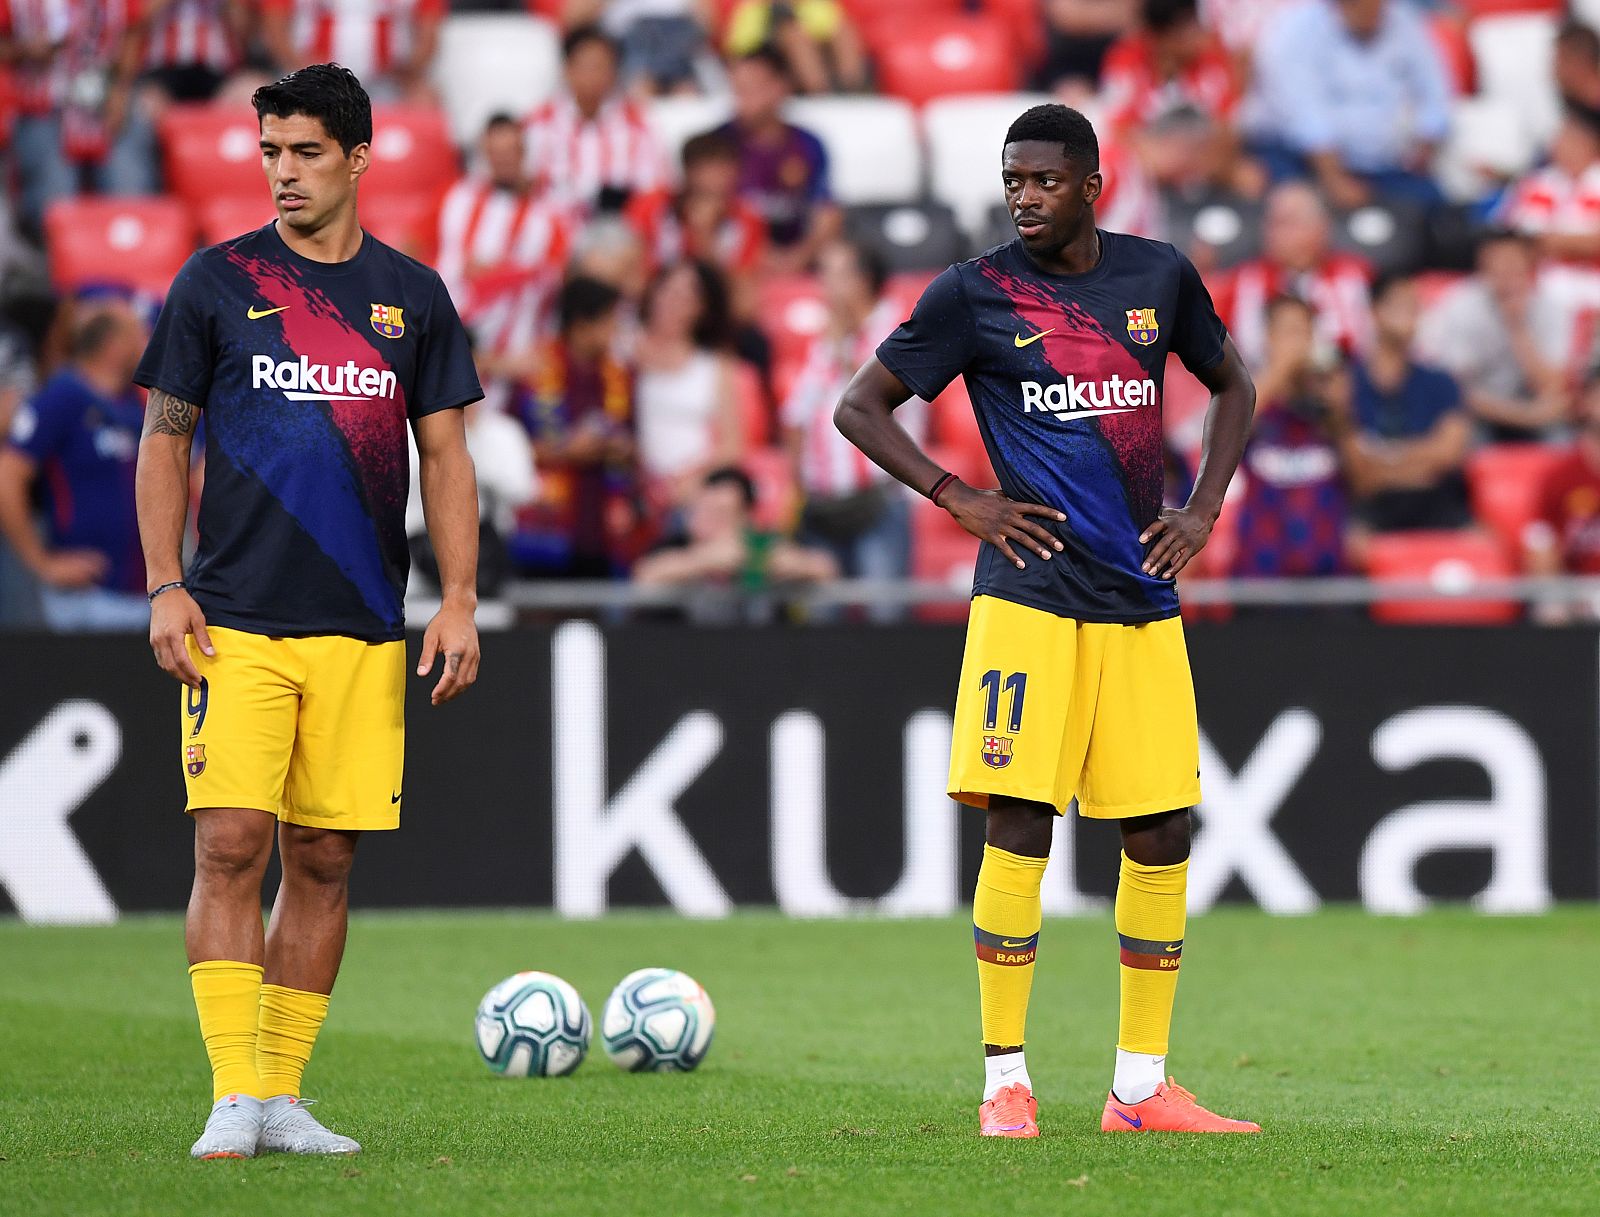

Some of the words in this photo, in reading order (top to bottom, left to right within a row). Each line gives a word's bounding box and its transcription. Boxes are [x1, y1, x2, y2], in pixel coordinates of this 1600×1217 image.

[252, 355, 397, 400] Rakuten
[1020, 374, 1156, 414] Rakuten
[187, 675, 209, 739] 9
[979, 670, 1028, 734] 11
[551, 620, 1550, 916] kuxa
